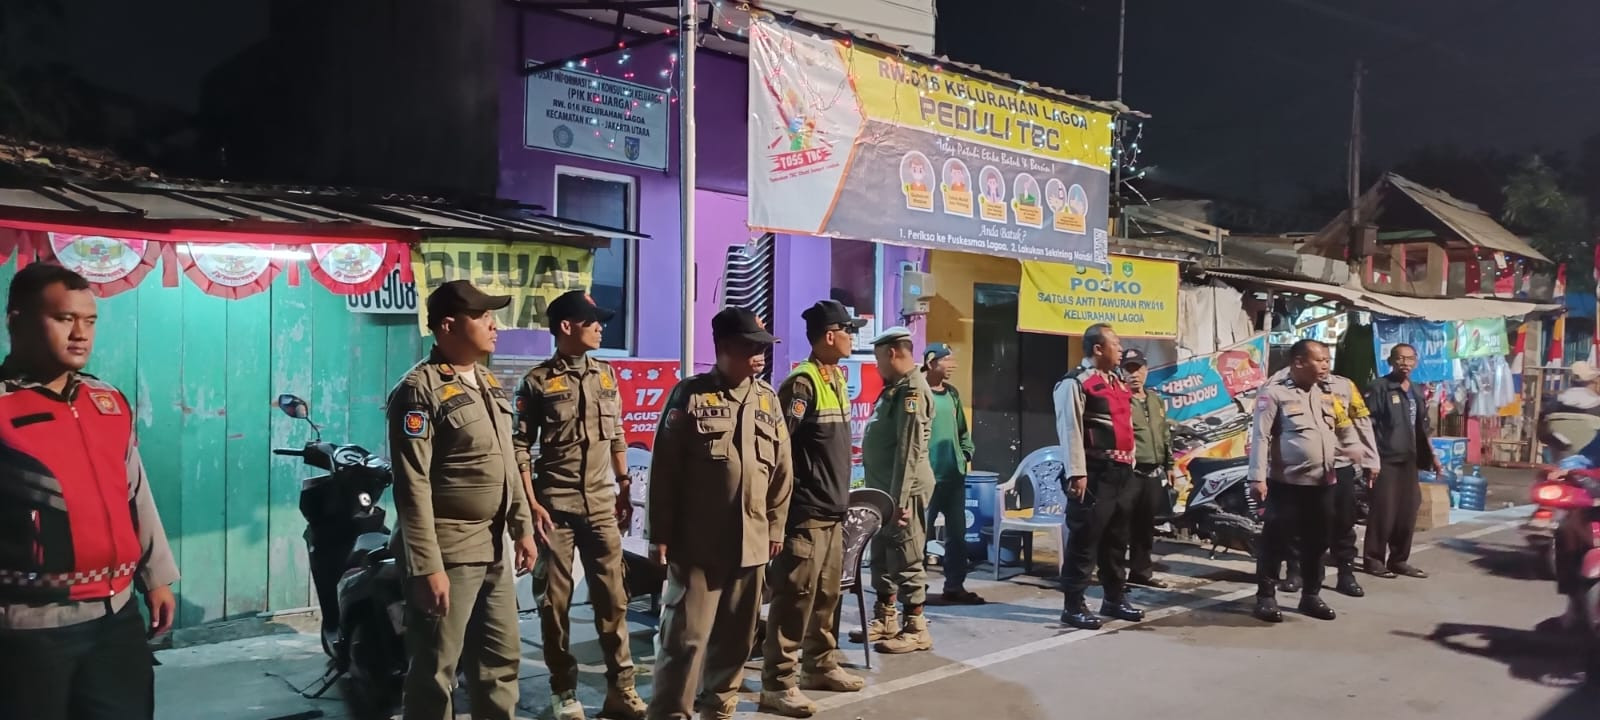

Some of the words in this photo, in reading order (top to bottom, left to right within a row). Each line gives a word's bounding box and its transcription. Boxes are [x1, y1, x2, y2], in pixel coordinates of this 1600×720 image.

[554, 71, 587, 88] INFORMASI
[588, 79, 600, 90] DN
[567, 87, 585, 101] (PIK
[877, 60, 941, 92] RW.016
[945, 79, 1039, 117] KELURAHAN
[1043, 106, 1089, 130] LAGOA
[552, 98, 566, 109] RW.
[581, 104, 623, 120] KELURAHAN
[546, 109, 584, 124] KECAMATAN
[585, 116, 600, 128] KO
[605, 120, 631, 133] JAKARTA
[631, 125, 650, 137] UTARA
[919, 96, 1011, 141] PEDULI
[1016, 120, 1060, 151] TBC
[780, 153, 804, 169] TOSS
[979, 224, 999, 238] Anda
[907, 229, 935, 242] Periksa
[936, 232, 946, 243] ke
[947, 234, 985, 248] Puskesmas
[1018, 244, 1045, 256] Lakukan
[424, 251, 588, 291] DIJUAL
[1070, 277, 1142, 295] POSKO
[1037, 292, 1074, 306] SATGAS
[1075, 296, 1096, 307] ANTI
[1097, 297, 1137, 310] TAWURAN
[1064, 309, 1116, 322] KELURAHAN
[1117, 313, 1145, 323] LAGOA
[636, 388, 664, 407] 17
[1172, 384, 1218, 409] AROMA
[624, 411, 661, 421] AGUS
